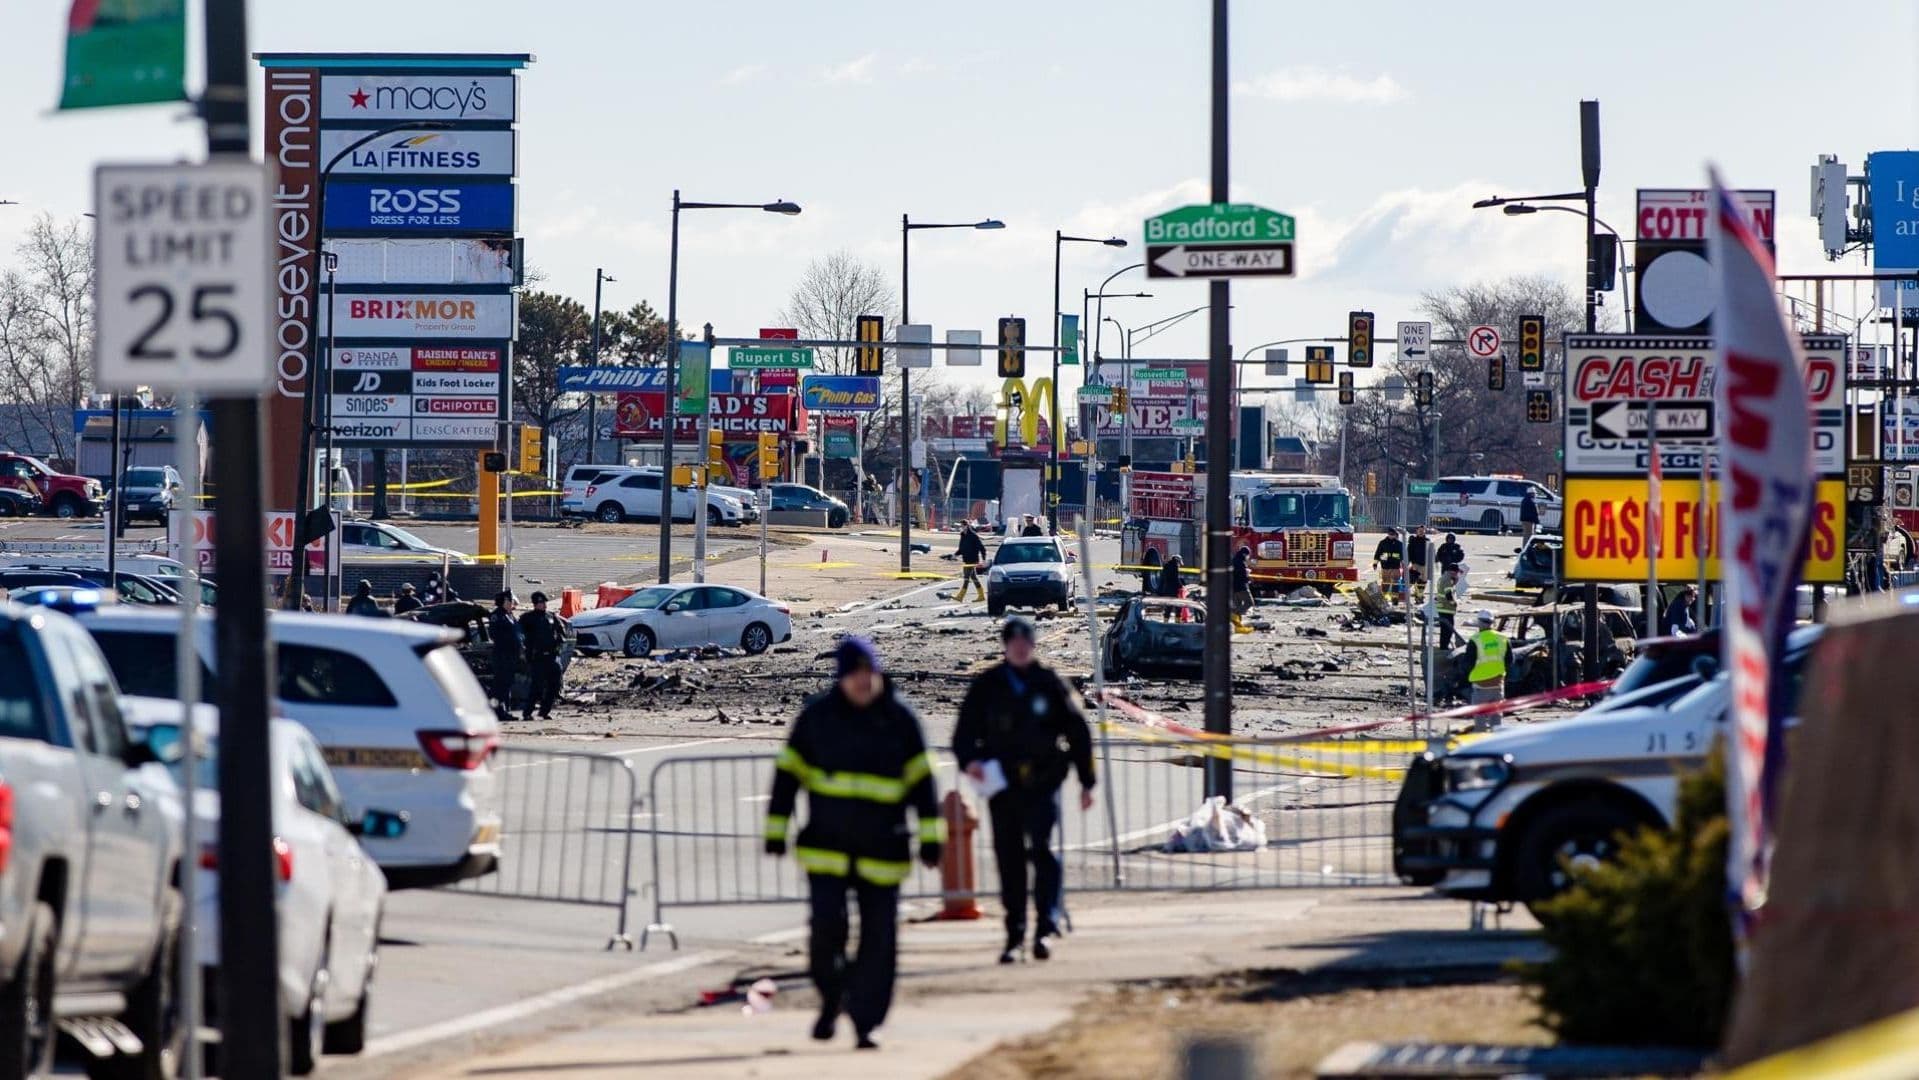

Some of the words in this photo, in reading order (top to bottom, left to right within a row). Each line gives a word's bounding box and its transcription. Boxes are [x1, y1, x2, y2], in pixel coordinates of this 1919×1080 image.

[271, 72, 311, 168] mall
[352, 152, 378, 168] LA
[387, 151, 481, 168] FITNESS
[110, 185, 253, 223] SPEED
[370, 188, 461, 213] ROSS
[370, 216, 404, 225] DRESS
[408, 216, 430, 225] FOR
[433, 216, 460, 225] LESS
[1149, 217, 1256, 239] Bradford
[1267, 216, 1291, 237] St
[125, 231, 232, 268] LIMIT
[350, 300, 476, 320] BRIXMOR
[127, 283, 241, 360] 25
[1403, 325, 1425, 335] ONE
[1403, 336, 1424, 345] WAY
[358, 351, 398, 360] PANDA
[417, 350, 459, 360] RAISING
[735, 351, 785, 363] Rupert
[791, 352, 806, 363] St
[416, 379, 436, 388] Kids
[439, 379, 460, 388] Foot
[463, 379, 496, 388] Locker
[586, 369, 651, 387] Philly
[1575, 356, 1705, 402] CASH
[819, 389, 854, 404] Philly
[854, 390, 877, 404] Gas
[346, 397, 389, 414] snipes
[433, 400, 494, 412] CHIPOTLE
[1667, 409, 1701, 427] WAY
